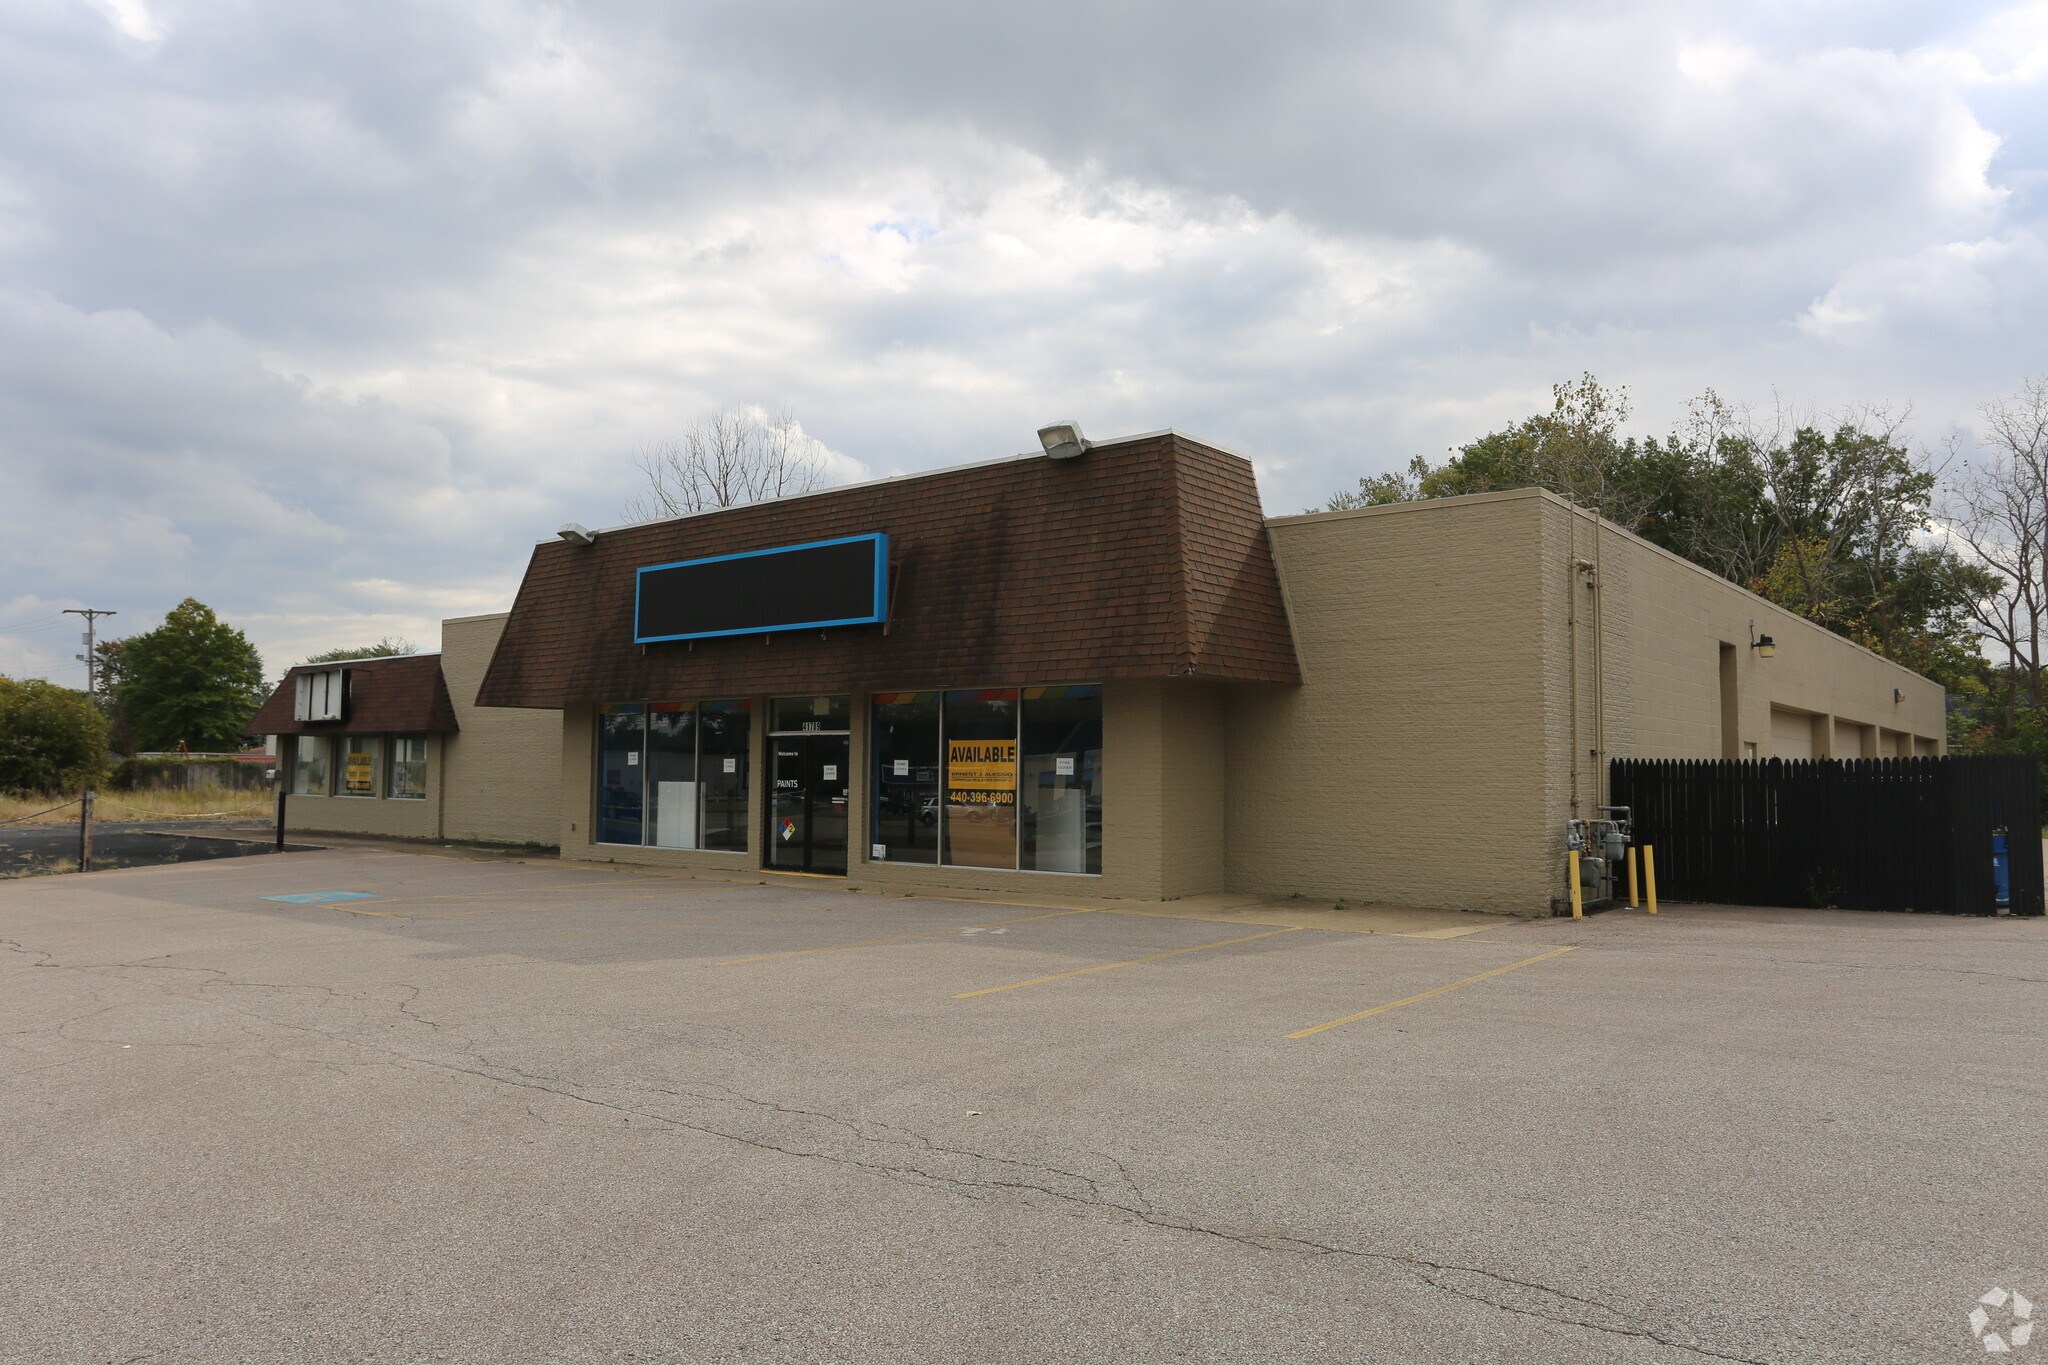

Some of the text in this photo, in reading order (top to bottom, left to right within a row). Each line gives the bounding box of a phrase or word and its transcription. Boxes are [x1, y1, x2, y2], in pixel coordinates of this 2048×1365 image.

[950, 746, 1014, 762] AVAILABLE
[777, 780, 798, 788] PAINTS
[951, 792, 1013, 803] 440-396-6900
